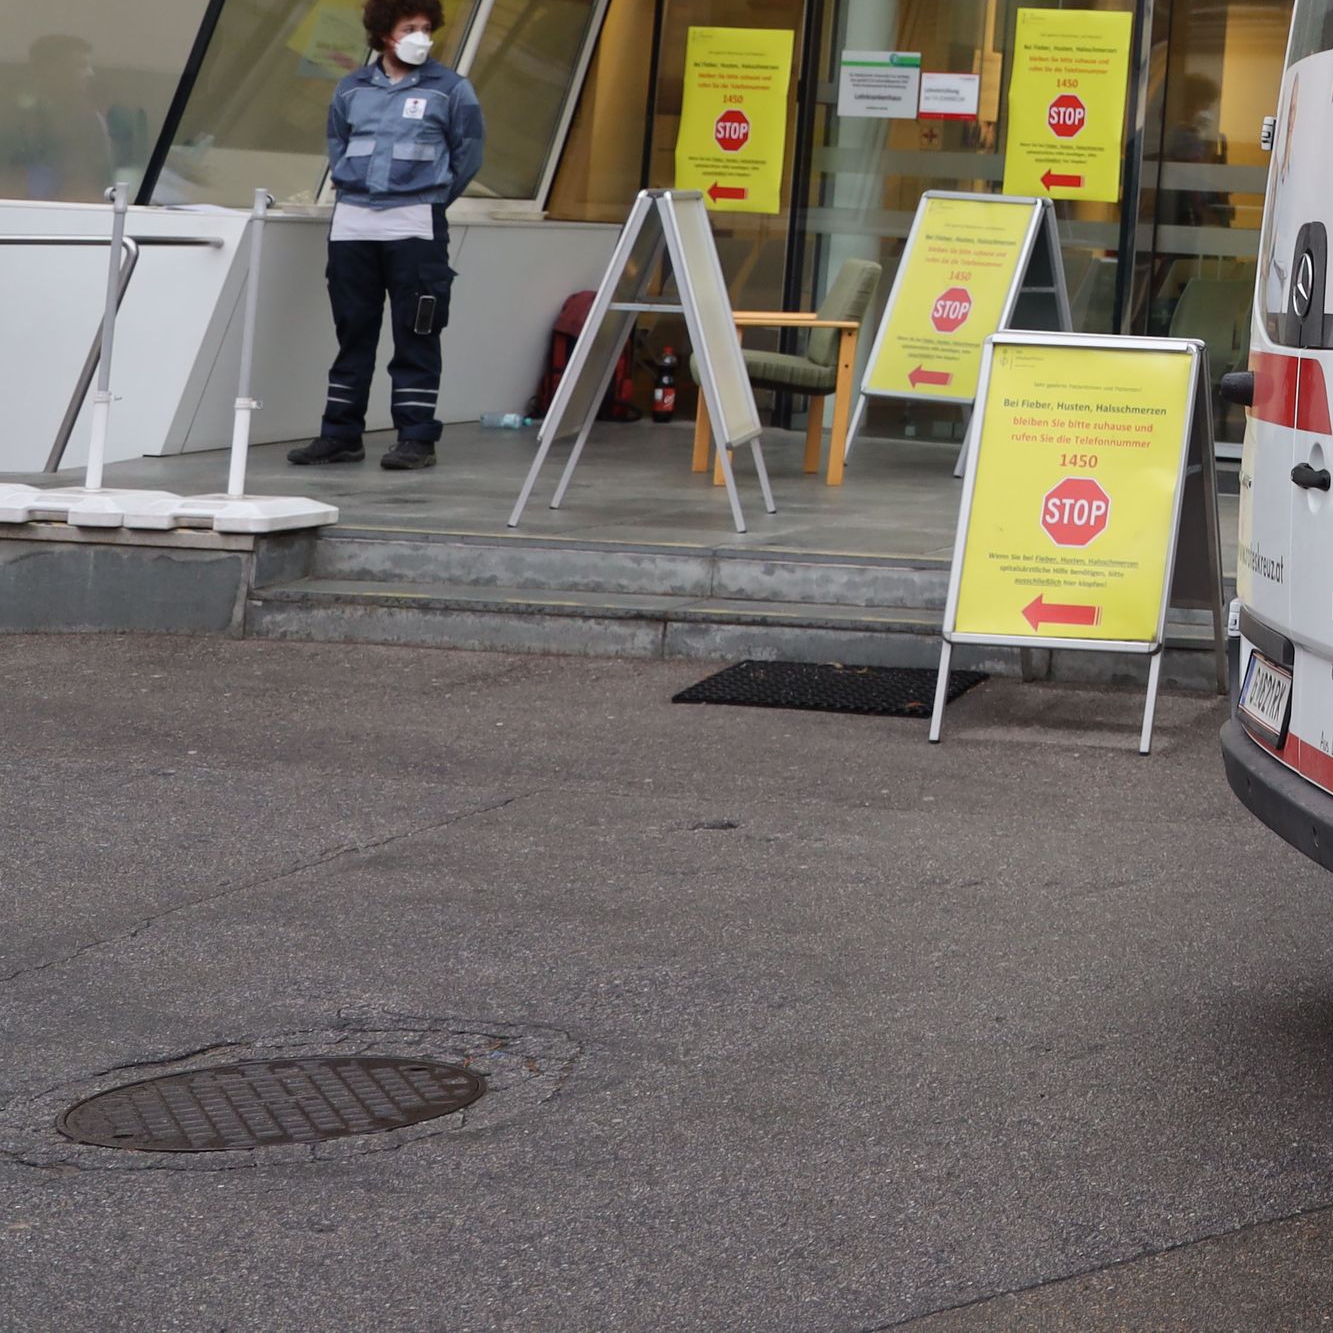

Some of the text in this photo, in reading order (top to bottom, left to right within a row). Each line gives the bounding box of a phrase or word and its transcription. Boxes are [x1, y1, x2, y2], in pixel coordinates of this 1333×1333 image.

[1056, 78, 1079, 89] 1450
[1049, 107, 1085, 126] STOP
[715, 121, 749, 140] STOP
[948, 270, 972, 281] 1450
[934, 300, 970, 320] STOP
[1003, 398, 1167, 416] Bei Fieber, Husten, Halsschmerzen
[1013, 417, 1153, 433] bleiben Sie bitte zuhause und
[1011, 433, 1151, 449] rufen Sie die Telefonnummer
[1060, 453, 1098, 469] 1450
[1045, 497, 1106, 526] STOP
